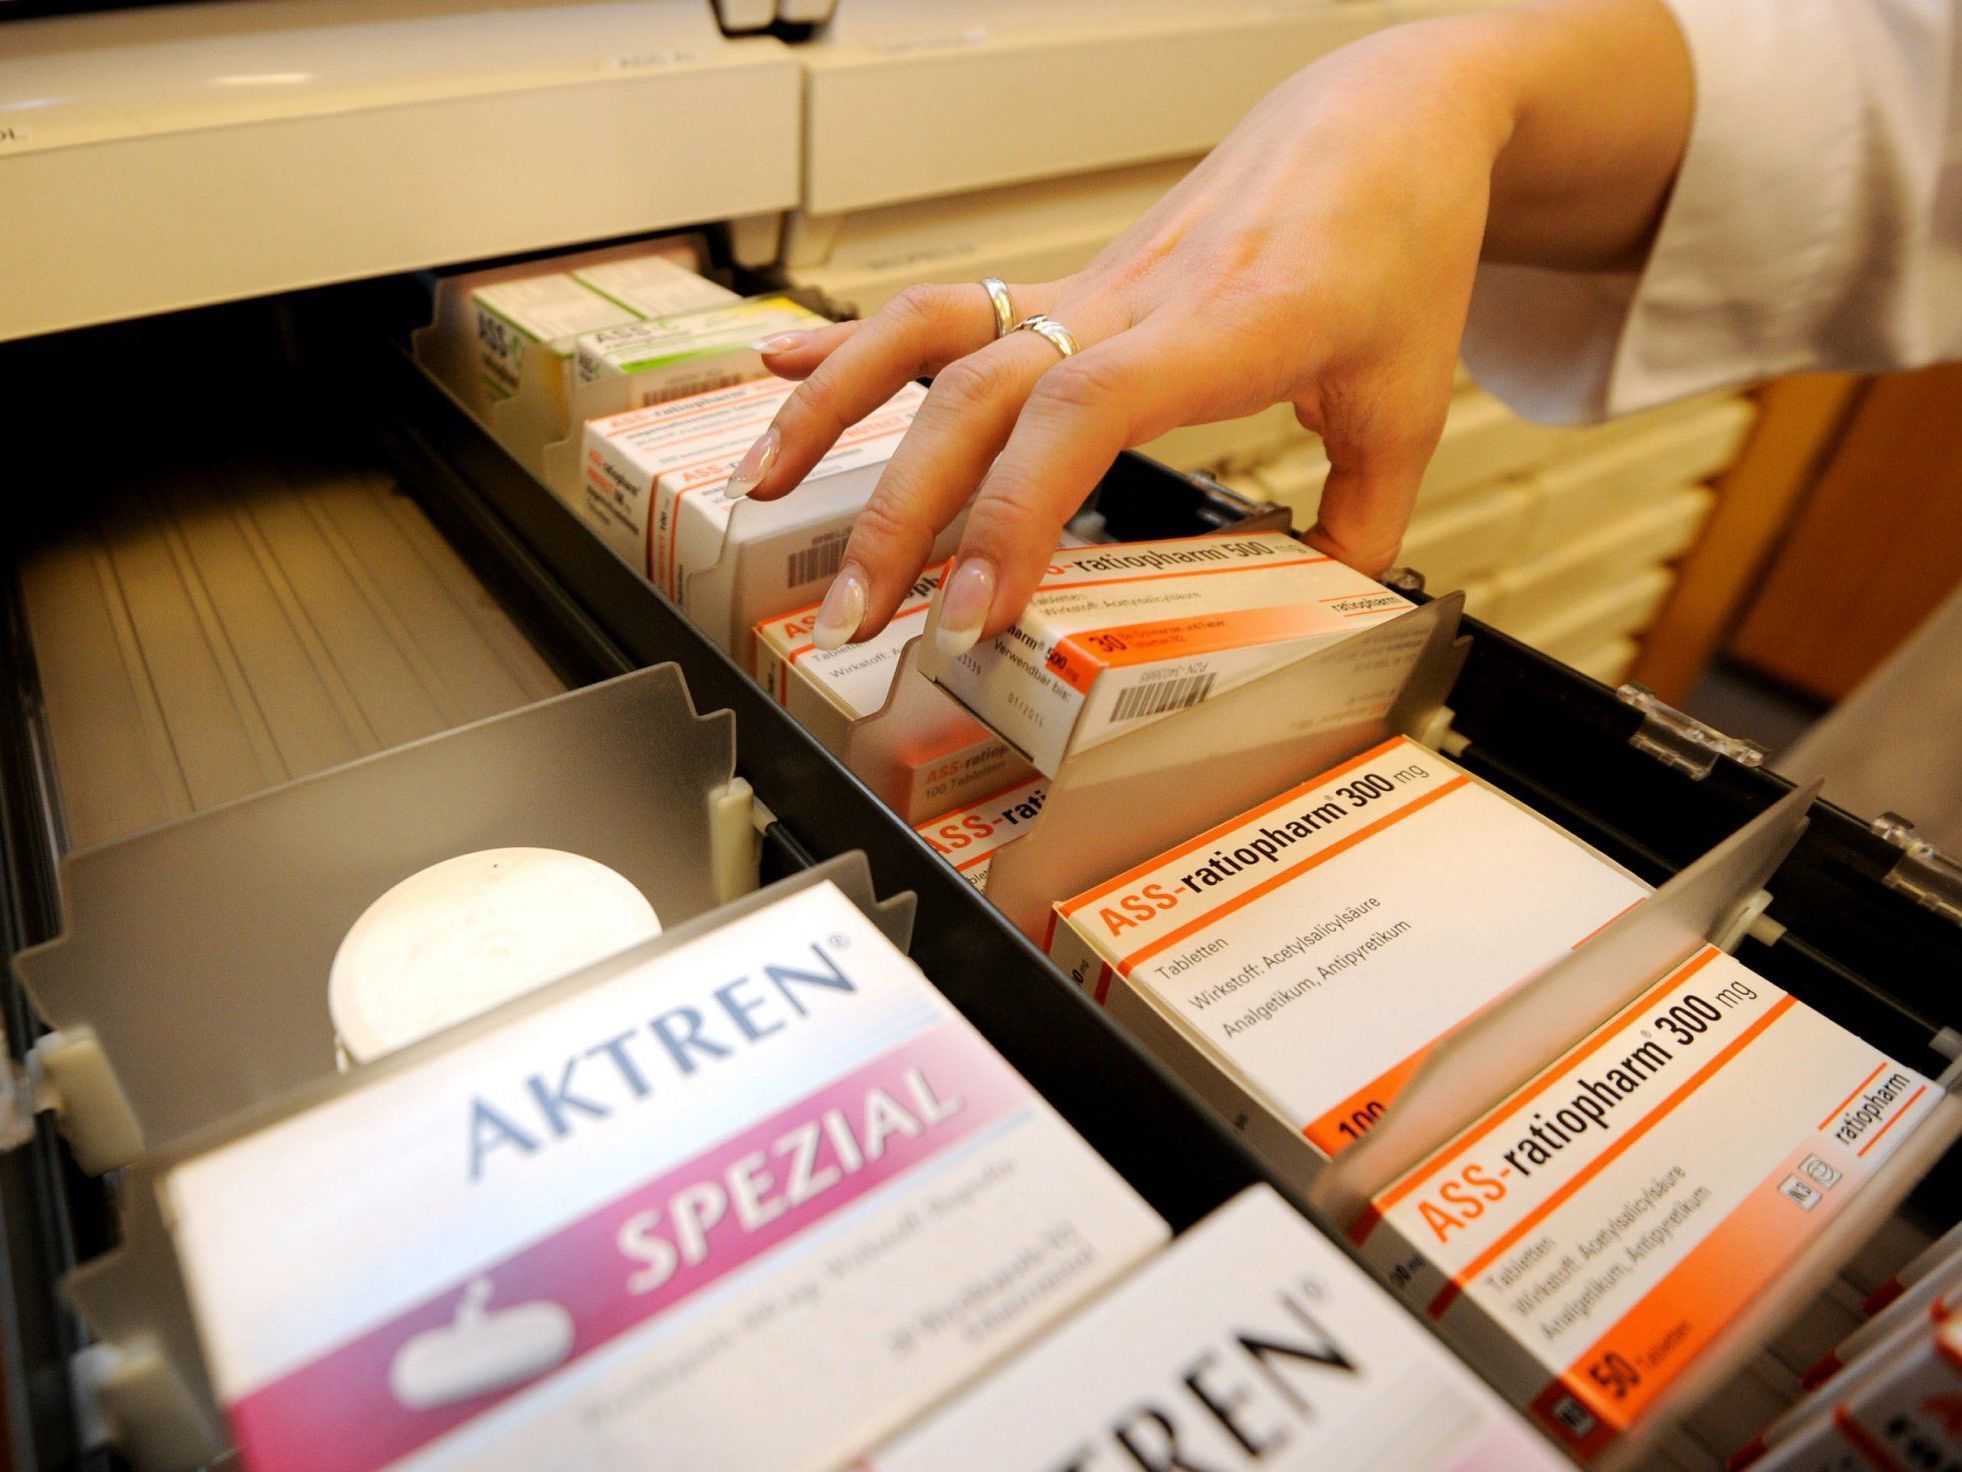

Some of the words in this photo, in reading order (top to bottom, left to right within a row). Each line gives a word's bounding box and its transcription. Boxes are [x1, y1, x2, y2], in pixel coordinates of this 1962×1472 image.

[1223, 541, 1275, 559] 500
[1329, 595, 1402, 613] ratiopharm
[829, 651, 890, 679] Wirkstoff:
[993, 637, 1052, 687] Verwendbar
[1045, 647, 1069, 670] 500
[1088, 634, 1128, 654] 30
[1335, 773, 1395, 808] 300
[1393, 764, 1430, 785] mg
[1154, 936, 1229, 980] Tabletten
[1189, 963, 1266, 1012] Wirkstoff:
[1261, 896, 1382, 970] Acetylsalicylsäure
[1222, 976, 1322, 1039] Analgetikum,
[1316, 919, 1413, 981] Antipyretikum
[1654, 993, 1722, 1047] 300
[1714, 980, 1758, 1009] mg
[1339, 1101, 1388, 1140] 100
[1835, 1073, 1911, 1146] ratiopharm
[616, 1066, 967, 1297] SPEZIAL
[1485, 1234, 1556, 1293] Tabletten
[1588, 1351, 1642, 1400] 50
